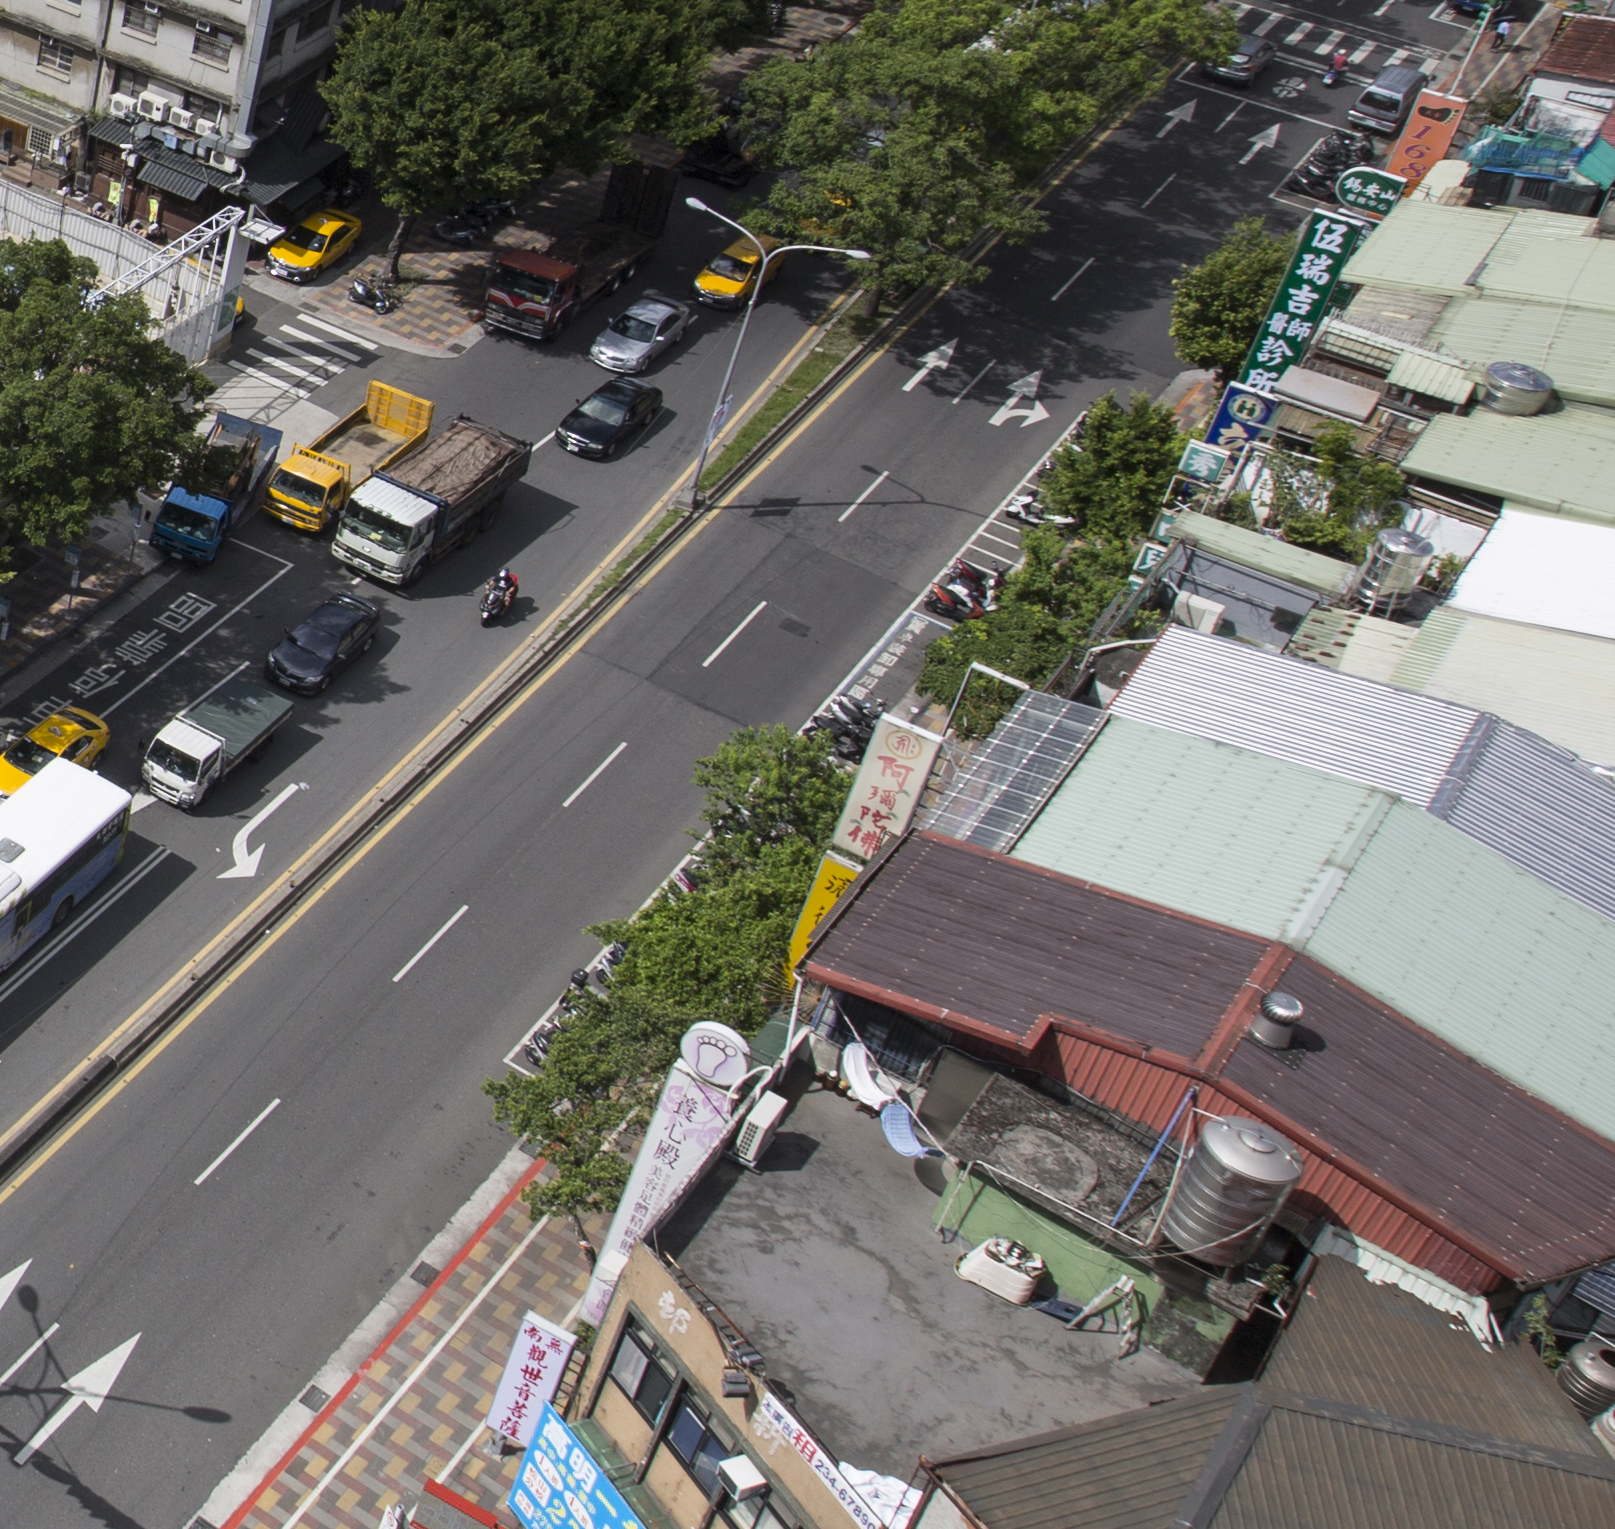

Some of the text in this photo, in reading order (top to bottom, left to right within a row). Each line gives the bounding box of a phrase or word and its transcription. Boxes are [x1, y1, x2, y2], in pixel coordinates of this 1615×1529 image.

[1400, 125, 1433, 179] 168
[1343, 176, 1396, 201] 錫安山
[792, 1428, 818, 1464] 租
